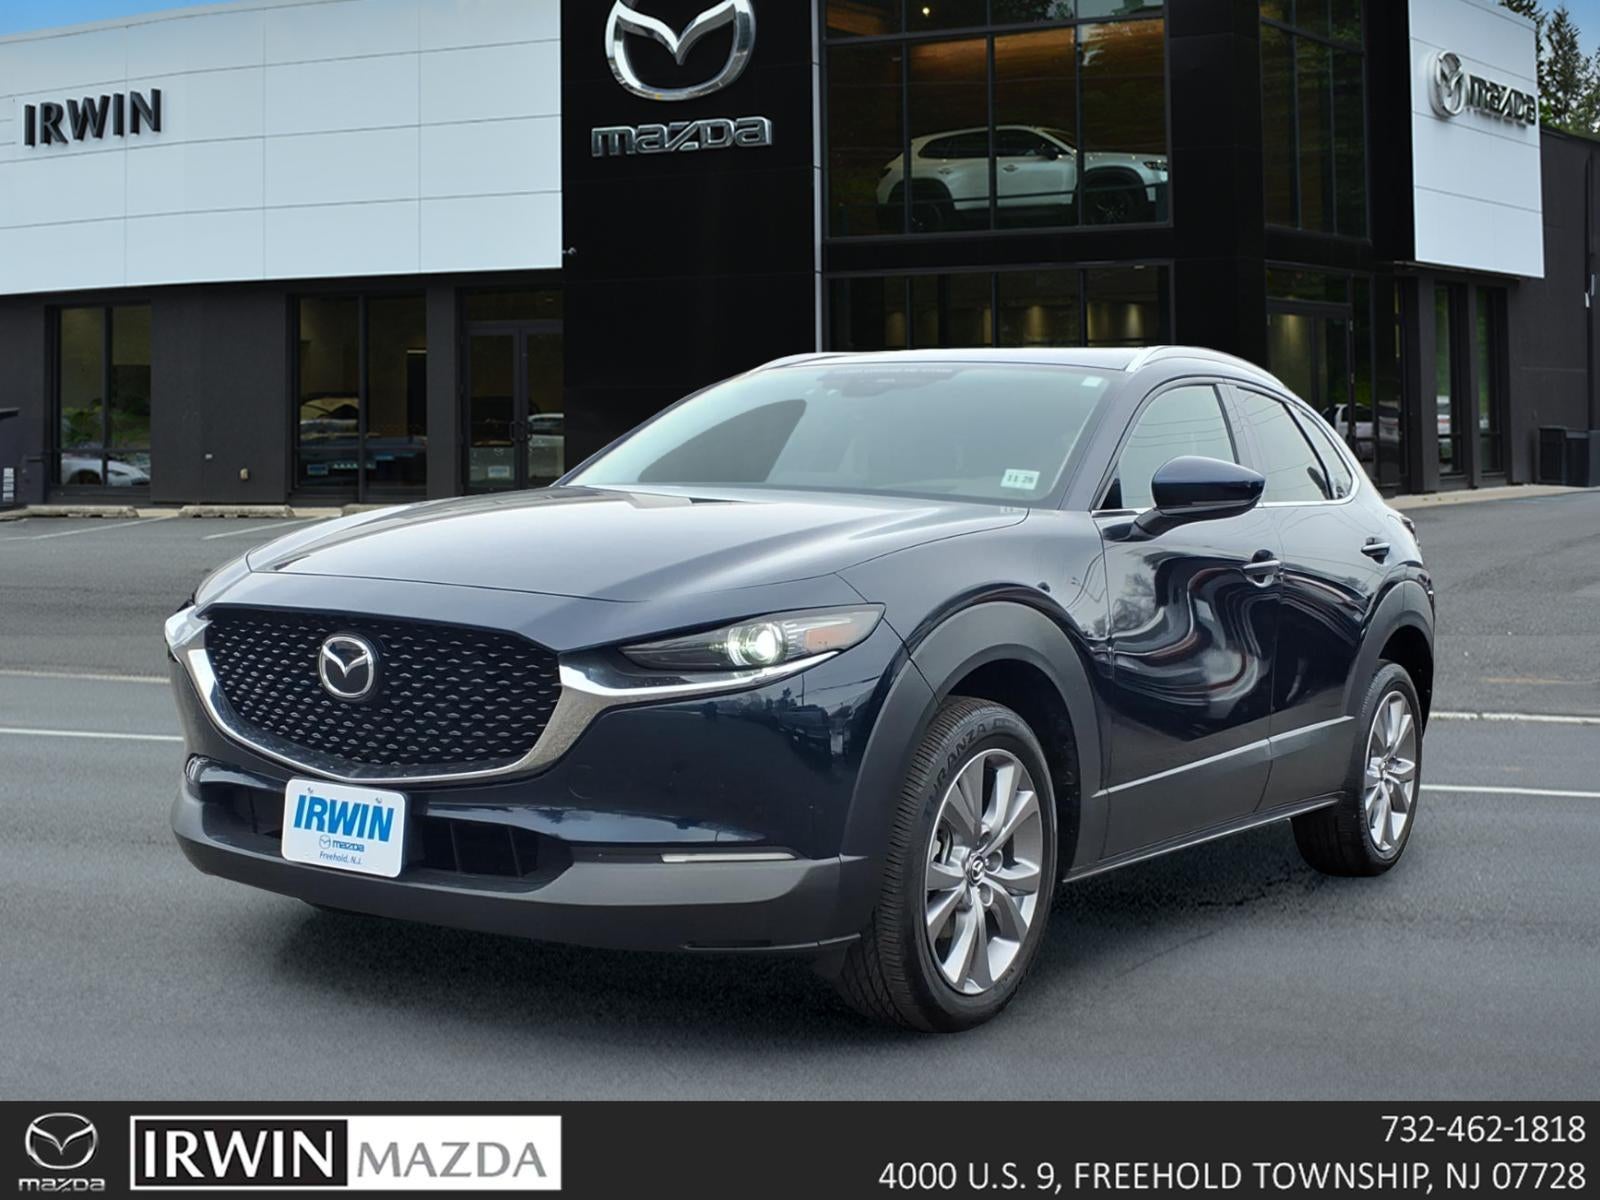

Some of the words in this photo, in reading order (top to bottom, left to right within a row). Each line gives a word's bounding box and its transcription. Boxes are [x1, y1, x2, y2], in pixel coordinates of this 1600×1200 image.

[24, 88, 162, 147] IRWIN
[592, 116, 772, 157] mazda
[294, 794, 395, 842] IRWIN
